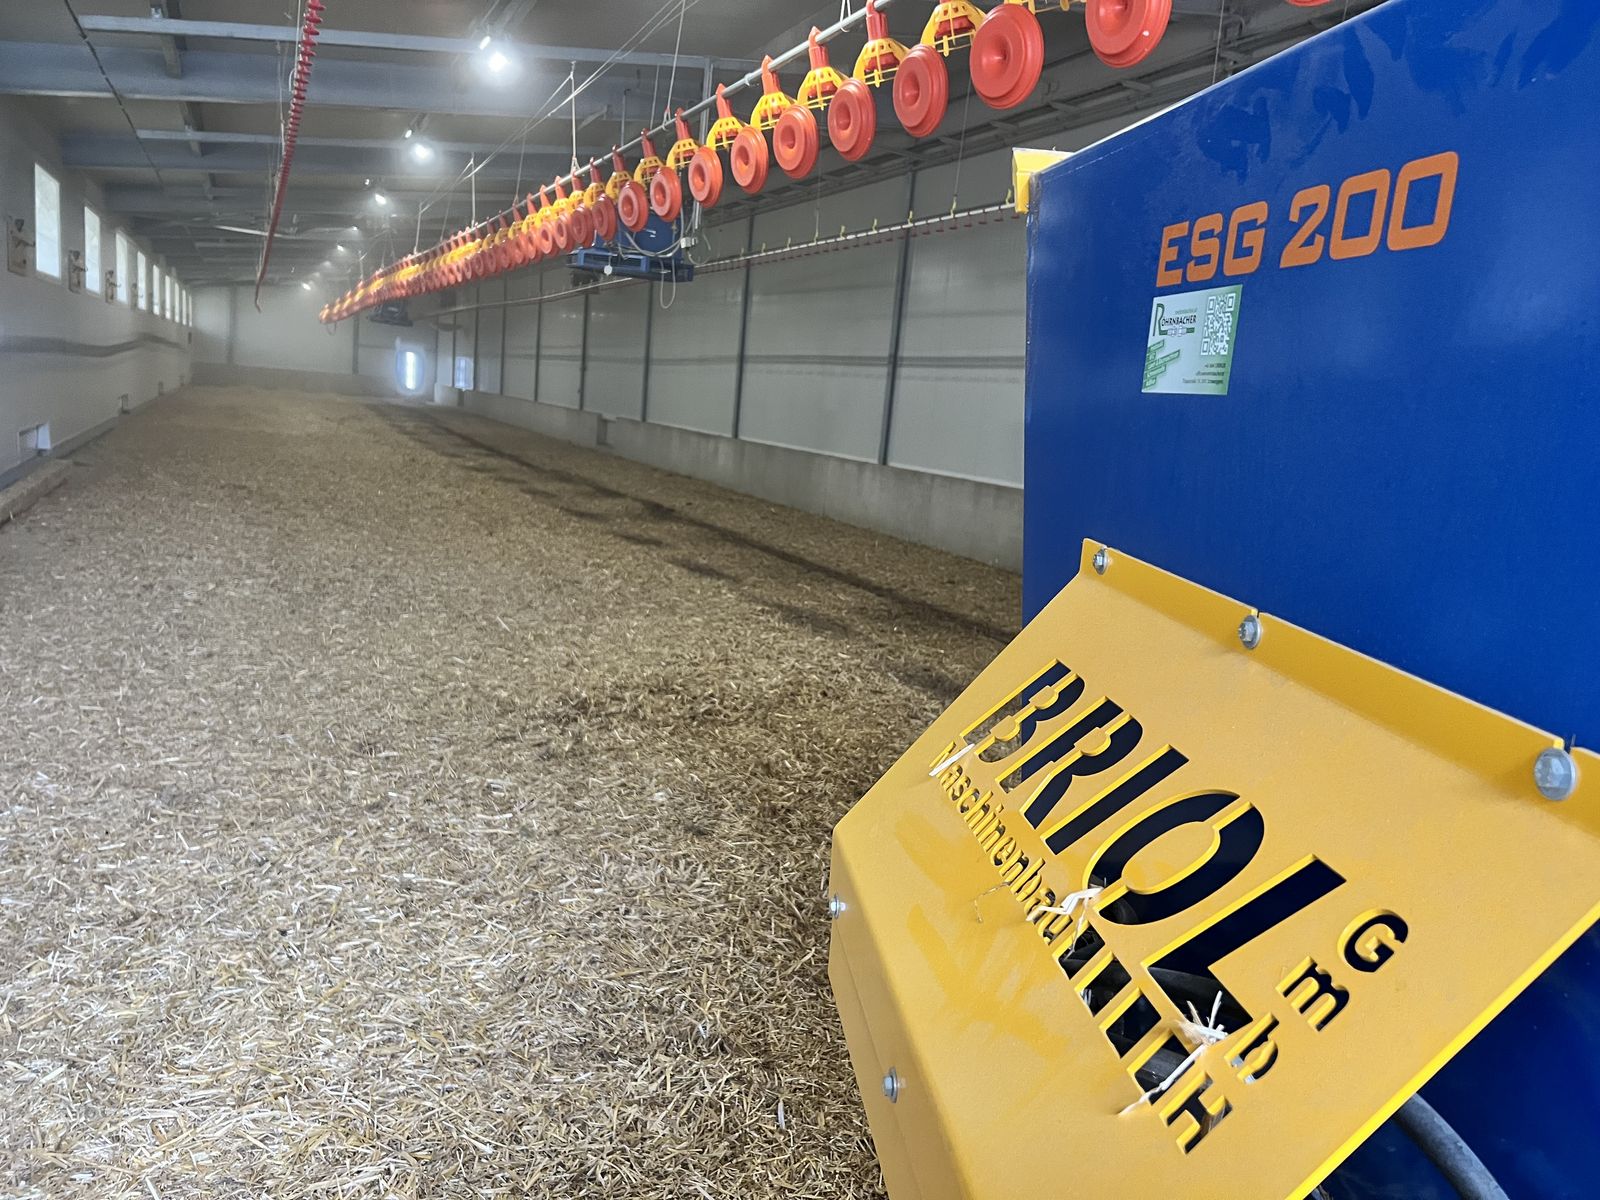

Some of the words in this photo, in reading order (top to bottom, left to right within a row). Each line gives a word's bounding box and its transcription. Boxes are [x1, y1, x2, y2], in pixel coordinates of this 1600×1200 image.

[1156, 201, 1268, 287] ESG
[1279, 151, 1459, 268] 200
[960, 658, 1347, 1047] BRIOL
